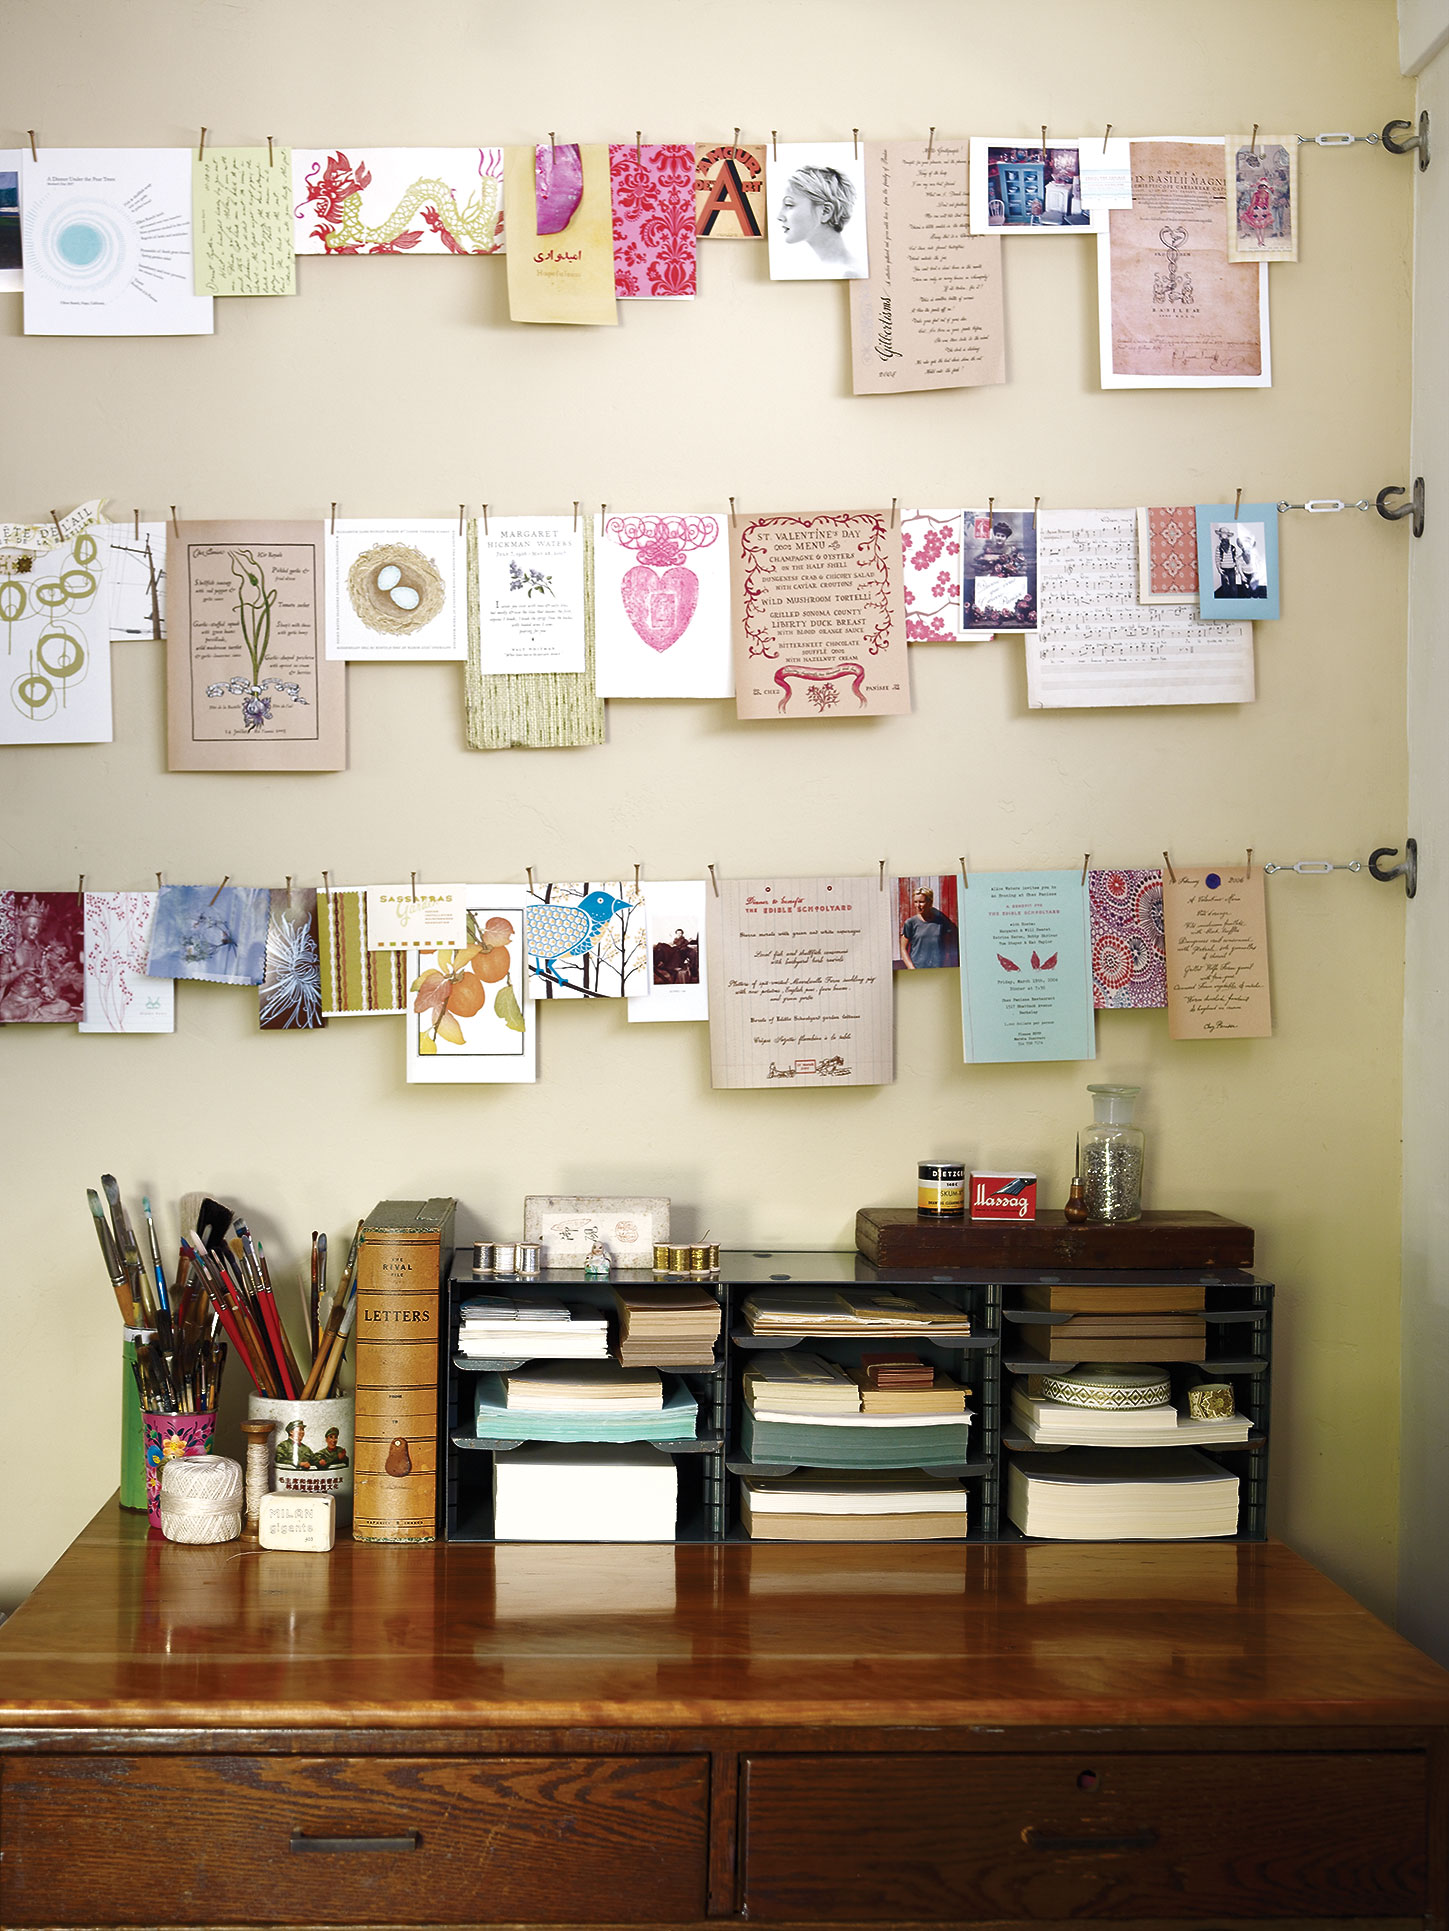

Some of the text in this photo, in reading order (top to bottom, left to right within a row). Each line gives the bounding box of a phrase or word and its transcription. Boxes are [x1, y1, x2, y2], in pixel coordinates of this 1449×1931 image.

[1148, 176, 1188, 184] BASILII
[874, 296, 904, 362] Gilbertisms
[40, 527, 59, 538] DE
[757, 529, 861, 541] ST. VALENTINE'S DAY
[795, 541, 826, 551] MENU
[769, 555, 814, 563] CHAMPAGNE
[761, 591, 872, 606] WILD MUSHROOM TORTELLI
[772, 620, 807, 628] LIBERTY
[745, 897, 769, 905] Dinner
[781, 896, 805, 908] benefit
[797, 905, 853, 913] SCHOOLYARD
[364, 1310, 430, 1321] LETTERS
[269, 1509, 313, 1519] MILAN
[270, 1523, 313, 1534] gigante
